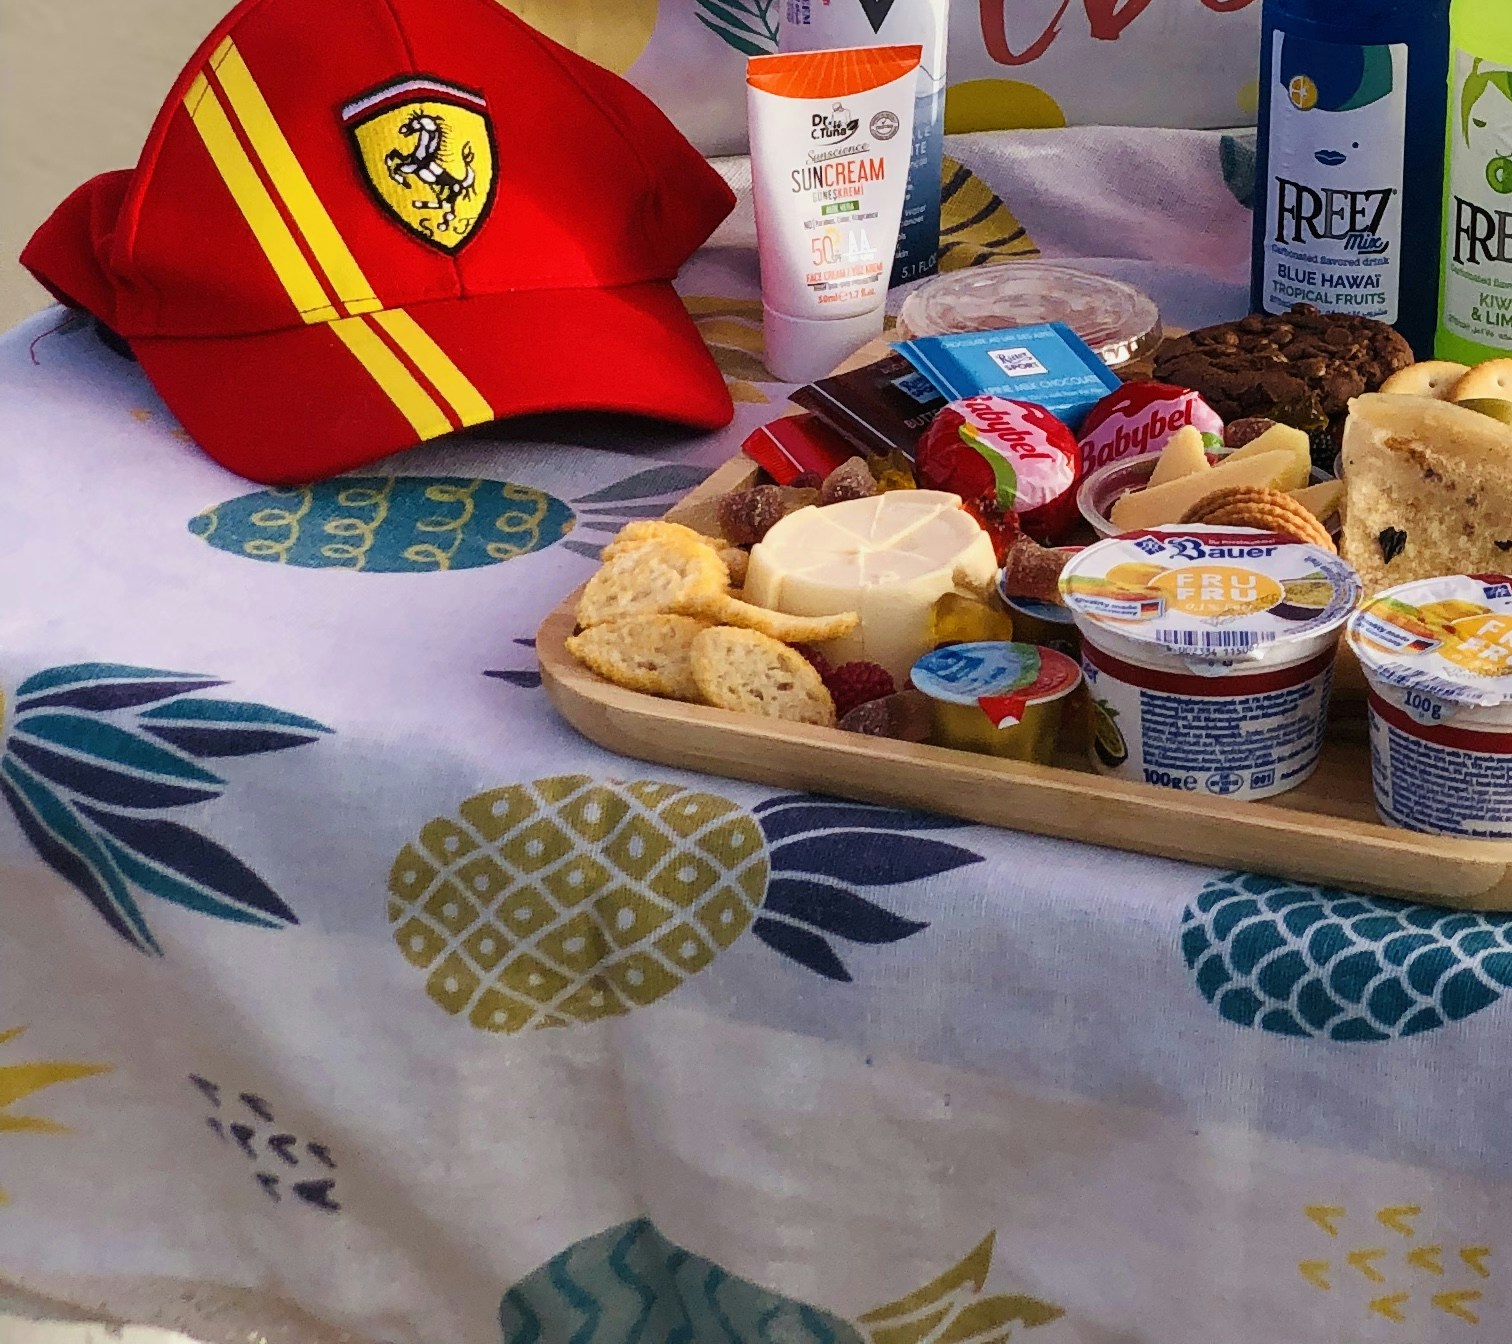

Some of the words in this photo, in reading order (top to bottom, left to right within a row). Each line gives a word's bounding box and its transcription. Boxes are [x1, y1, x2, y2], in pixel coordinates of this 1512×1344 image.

[791, 156, 885, 193] SUNCREAM
[1275, 175, 1393, 245] FREEZ
[1319, 256, 1361, 267] flavored
[1362, 256, 1390, 267] drink
[1277, 263, 1317, 286] BLUE
[1272, 279, 1333, 305] TROPICAL
[1335, 292, 1386, 306] FRUITS
[1471, 306, 1483, 322] &
[1004, 362, 1040, 372] SPORT
[1080, 398, 1193, 475] Babybel
[1167, 538, 1278, 561] Bauer
[1176, 573, 1257, 588] FRU
[1176, 587, 1258, 602] FRU
[1385, 630, 1410, 642] made
[1403, 691, 1443, 721] 100g
